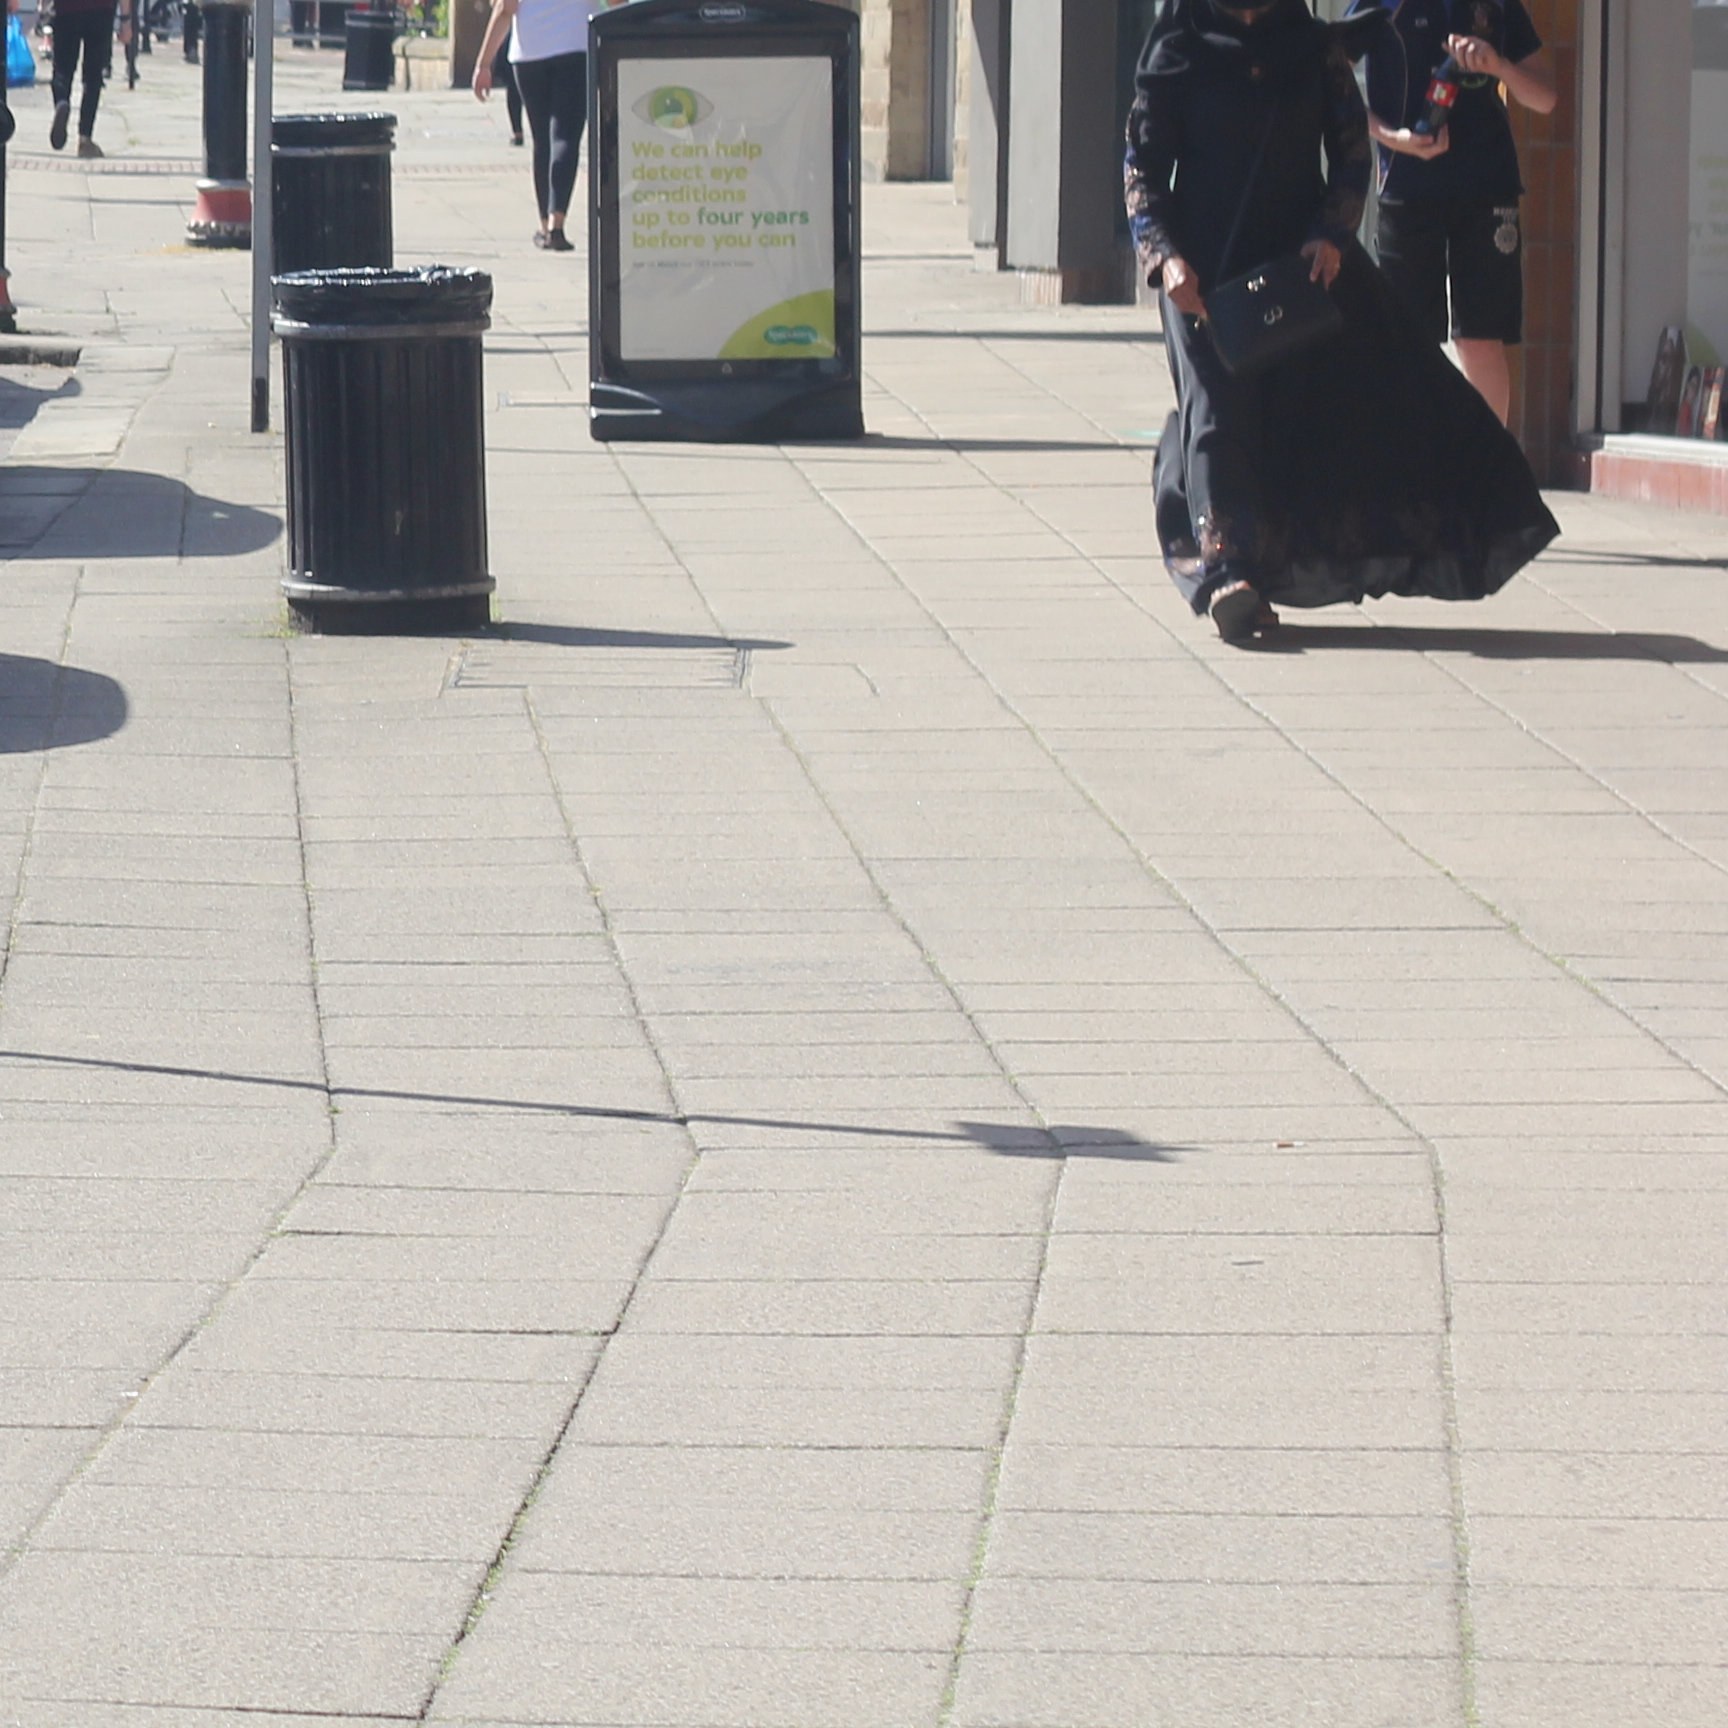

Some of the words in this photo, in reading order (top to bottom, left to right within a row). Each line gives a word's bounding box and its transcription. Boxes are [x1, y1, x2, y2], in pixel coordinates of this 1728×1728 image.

[632, 141, 665, 158] We
[670, 144, 709, 158] can
[715, 139, 762, 160] help
[632, 163, 703, 180] detect
[710, 166, 748, 183] eye
[632, 183, 748, 203] conditions
[632, 211, 661, 229] up
[667, 209, 690, 226] to
[698, 206, 743, 225] four
[751, 210, 810, 229] years
[632, 230, 706, 249] before
[713, 233, 752, 251] you
[758, 233, 796, 248] can
